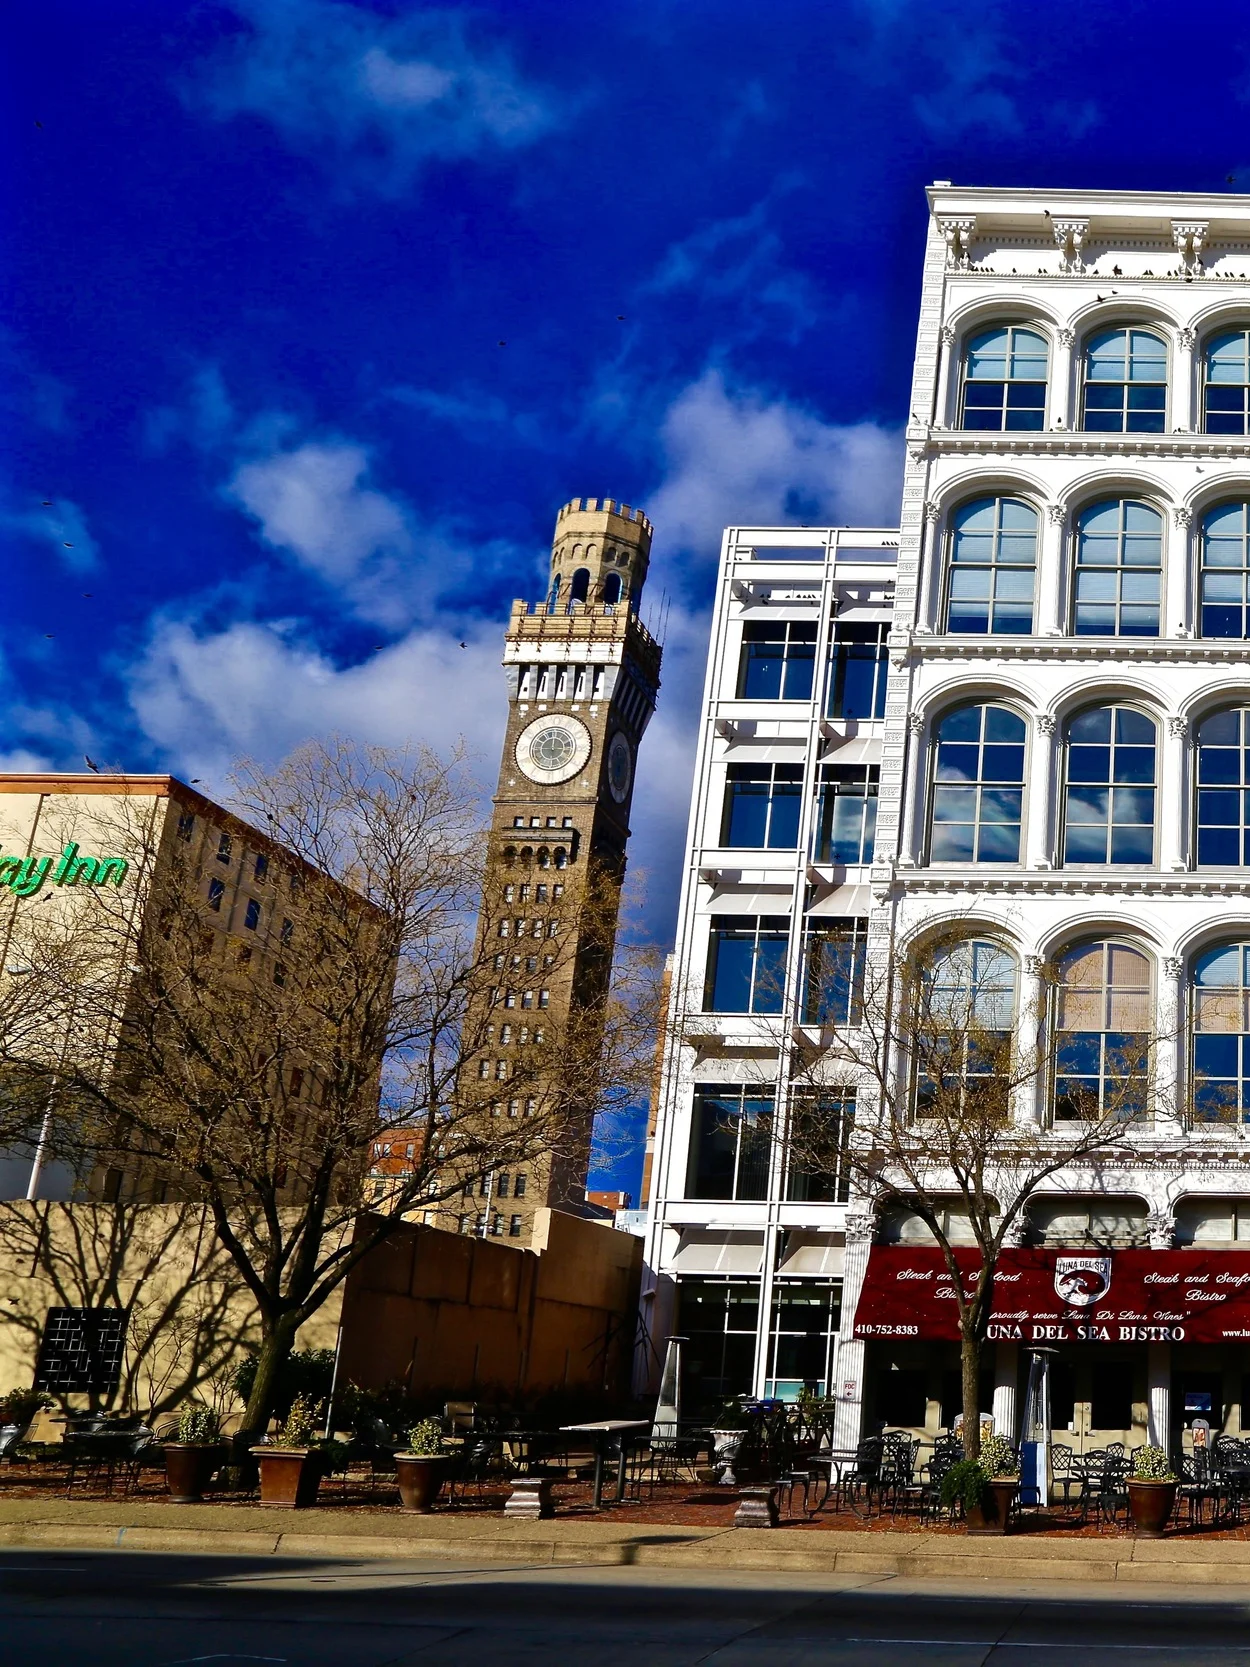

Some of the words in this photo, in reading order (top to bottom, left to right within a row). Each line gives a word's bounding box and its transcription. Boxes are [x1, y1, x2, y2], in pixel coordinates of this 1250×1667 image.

[0, 856, 54, 897] ay
[52, 841, 129, 887] Inn
[896, 1269, 934, 1280] Steak
[1058, 1260, 1078, 1273] LUNA
[1080, 1260, 1092, 1268] DEL
[1094, 1261, 1108, 1276] SEA
[1143, 1272, 1180, 1284] Steak
[1184, 1273, 1210, 1284] and
[1184, 1288, 1228, 1301] Bistro
[989, 1310, 1029, 1323] proudly
[1061, 1310, 1091, 1320] Luna
[1096, 1310, 1115, 1320] Di
[1117, 1310, 1148, 1320] Luna
[854, 1324, 919, 1335] 410-752-8383
[982, 1325, 1023, 1340] UNA
[1032, 1325, 1069, 1340] DEL
[1077, 1325, 1111, 1340] SEA
[1118, 1326, 1185, 1341] BISTRO
